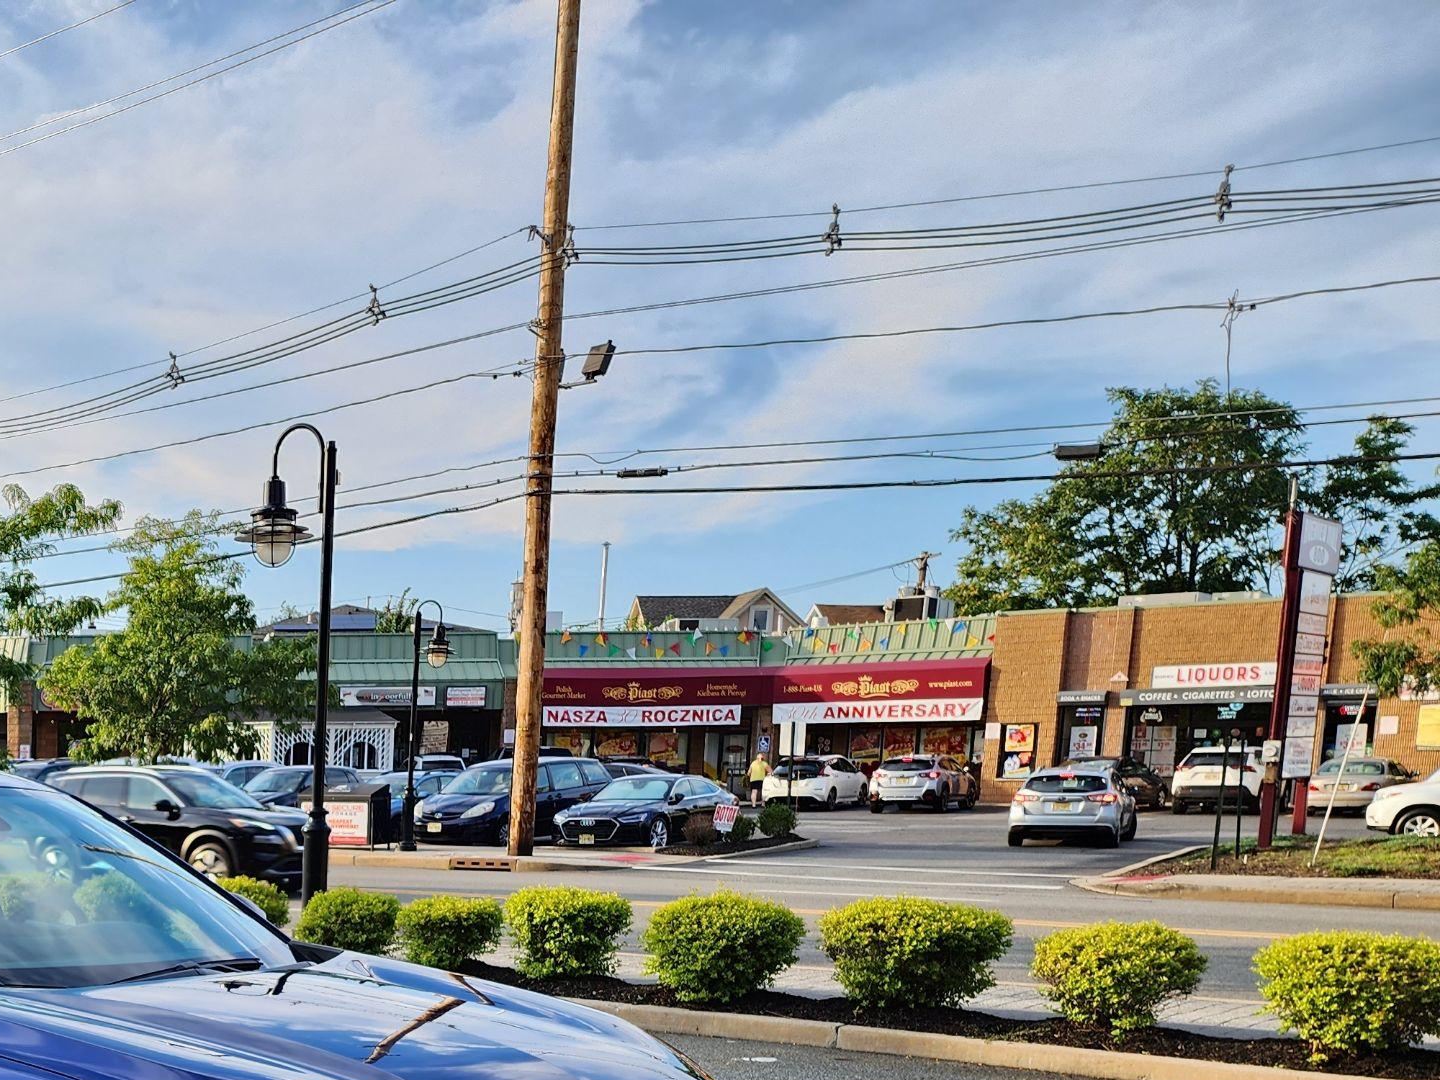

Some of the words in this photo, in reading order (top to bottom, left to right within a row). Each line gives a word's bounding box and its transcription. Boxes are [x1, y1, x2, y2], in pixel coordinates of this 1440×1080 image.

[1177, 666, 1260, 683] LIQUORS
[859, 681, 890, 695] Piast
[928, 680, 972, 689] www.piast.com
[542, 691, 566, 699] Gourmet
[567, 691, 586, 699] Market
[629, 687, 658, 700] Piast
[1139, 692, 1173, 701] COFFEE
[1182, 690, 1235, 700] CIGARETTES
[547, 709, 608, 723] NASZA
[612, 709, 639, 723] 30
[641, 709, 736, 722] ROCZNICA
[823, 703, 971, 720] ANNIVERSARY
[714, 806, 737, 822] BOTOX
